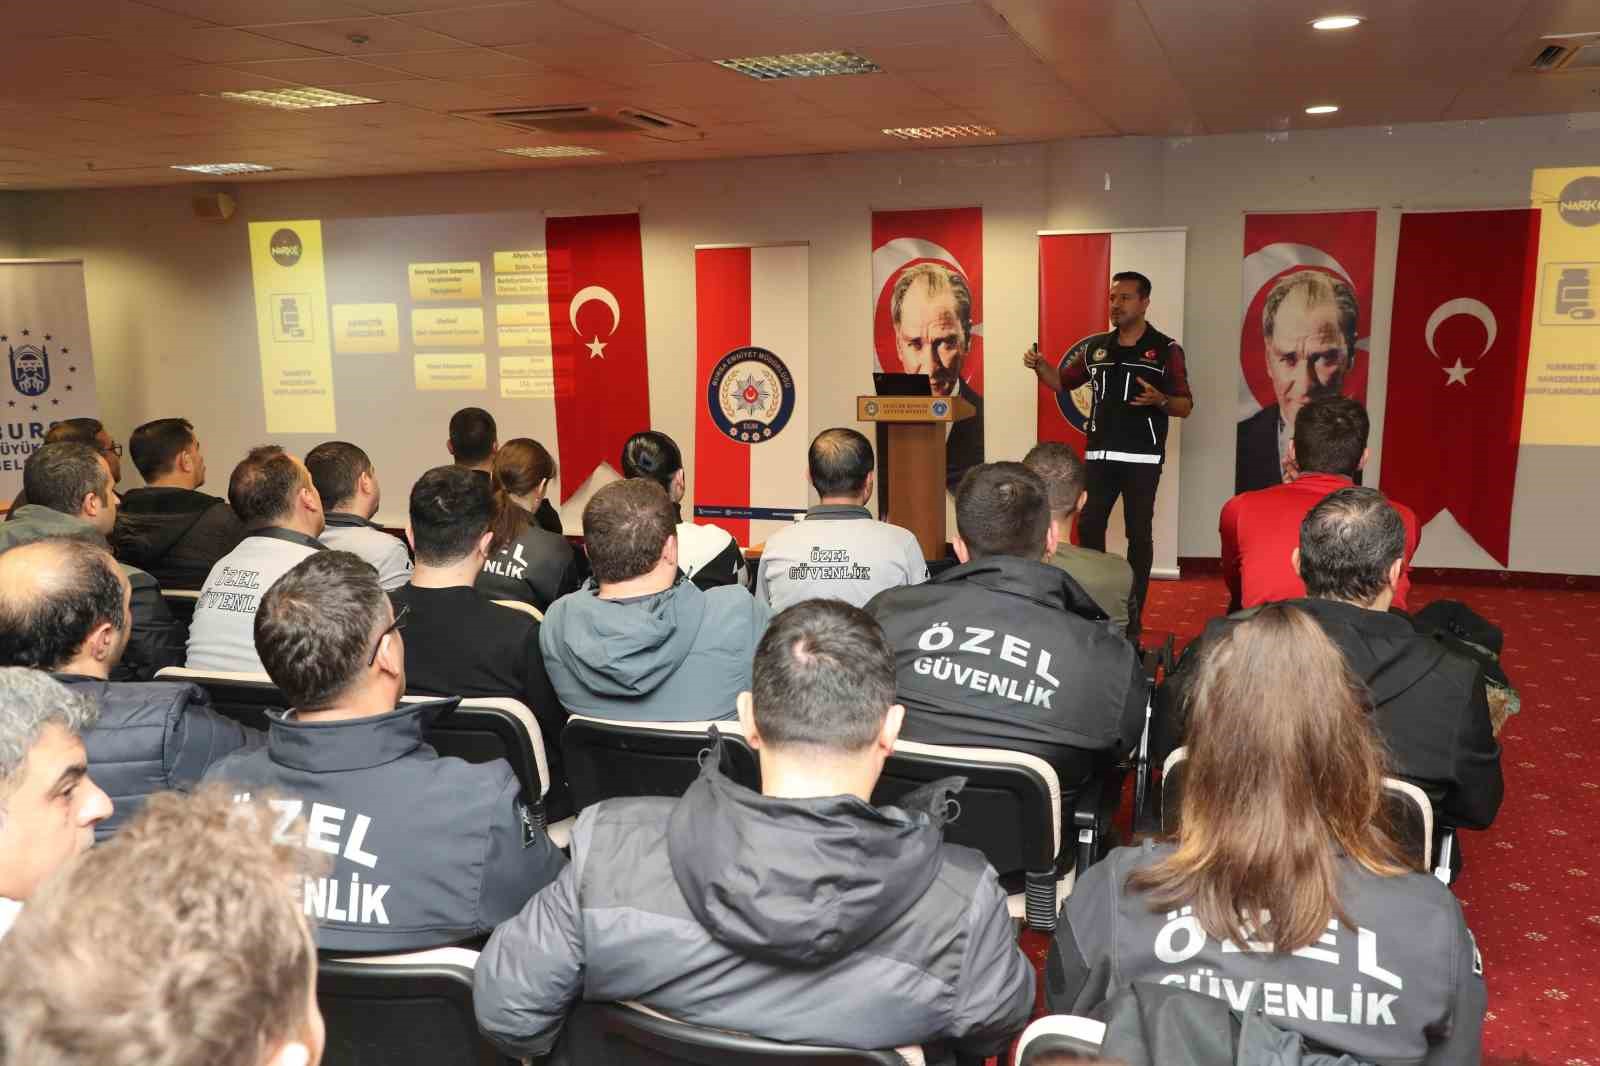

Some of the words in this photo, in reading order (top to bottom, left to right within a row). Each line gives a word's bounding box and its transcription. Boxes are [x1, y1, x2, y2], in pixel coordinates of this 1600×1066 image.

[789, 563, 871, 580] GÜVENLİK
[810, 546, 850, 562] ÖZEL
[918, 621, 1060, 688] ÖZEL
[913, 655, 1056, 709] GÜVENLİK
[302, 872, 391, 924] NLİK
[1159, 967, 1399, 1026] ÜVENLİK
